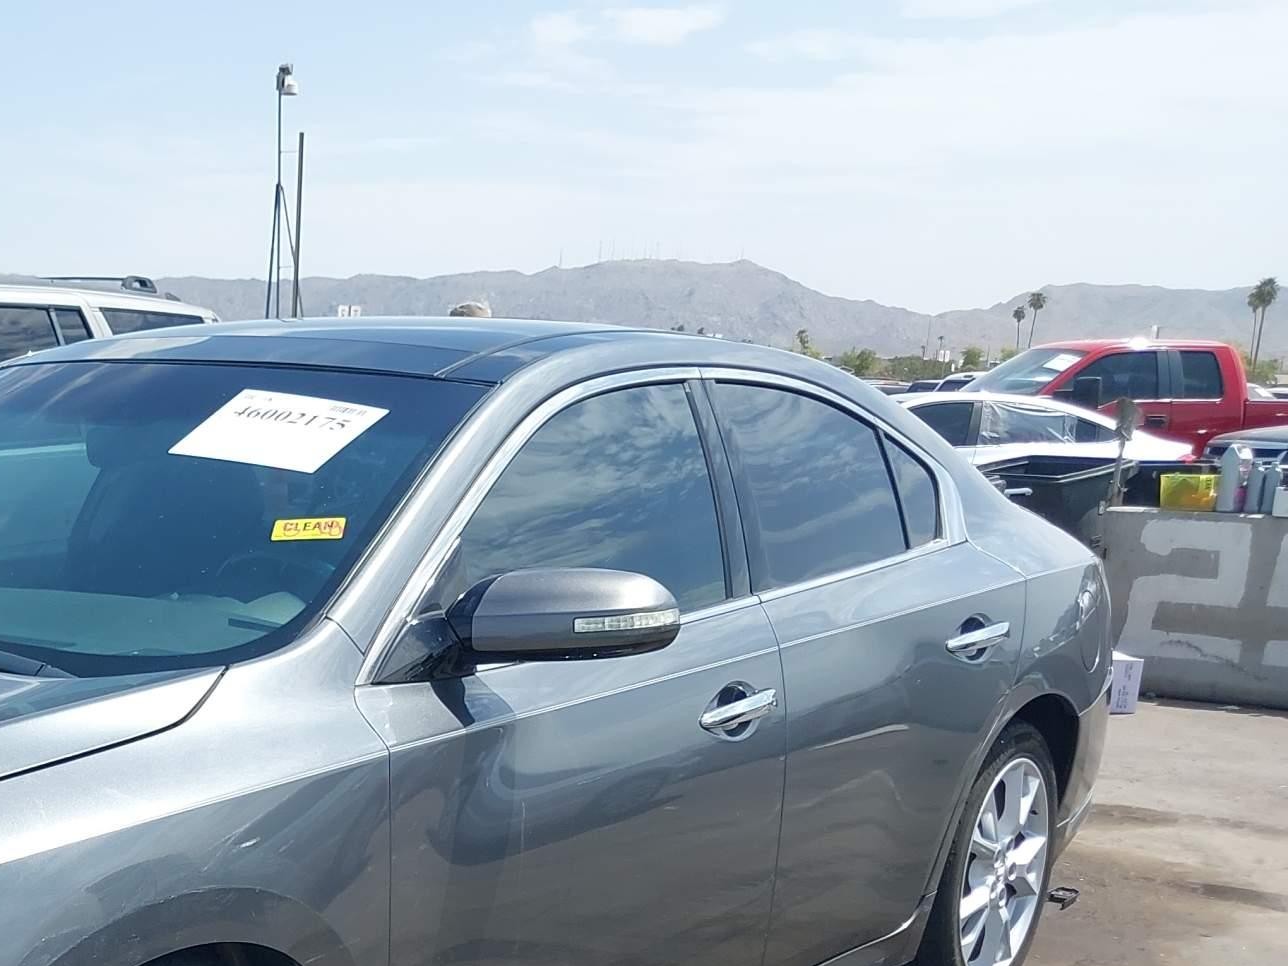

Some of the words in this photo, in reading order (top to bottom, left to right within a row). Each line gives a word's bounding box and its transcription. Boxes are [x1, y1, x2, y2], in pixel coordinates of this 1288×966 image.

[233, 405, 353, 431] 46002175
[283, 520, 335, 533] CLEAN
[1115, 518, 1288, 667] 2
